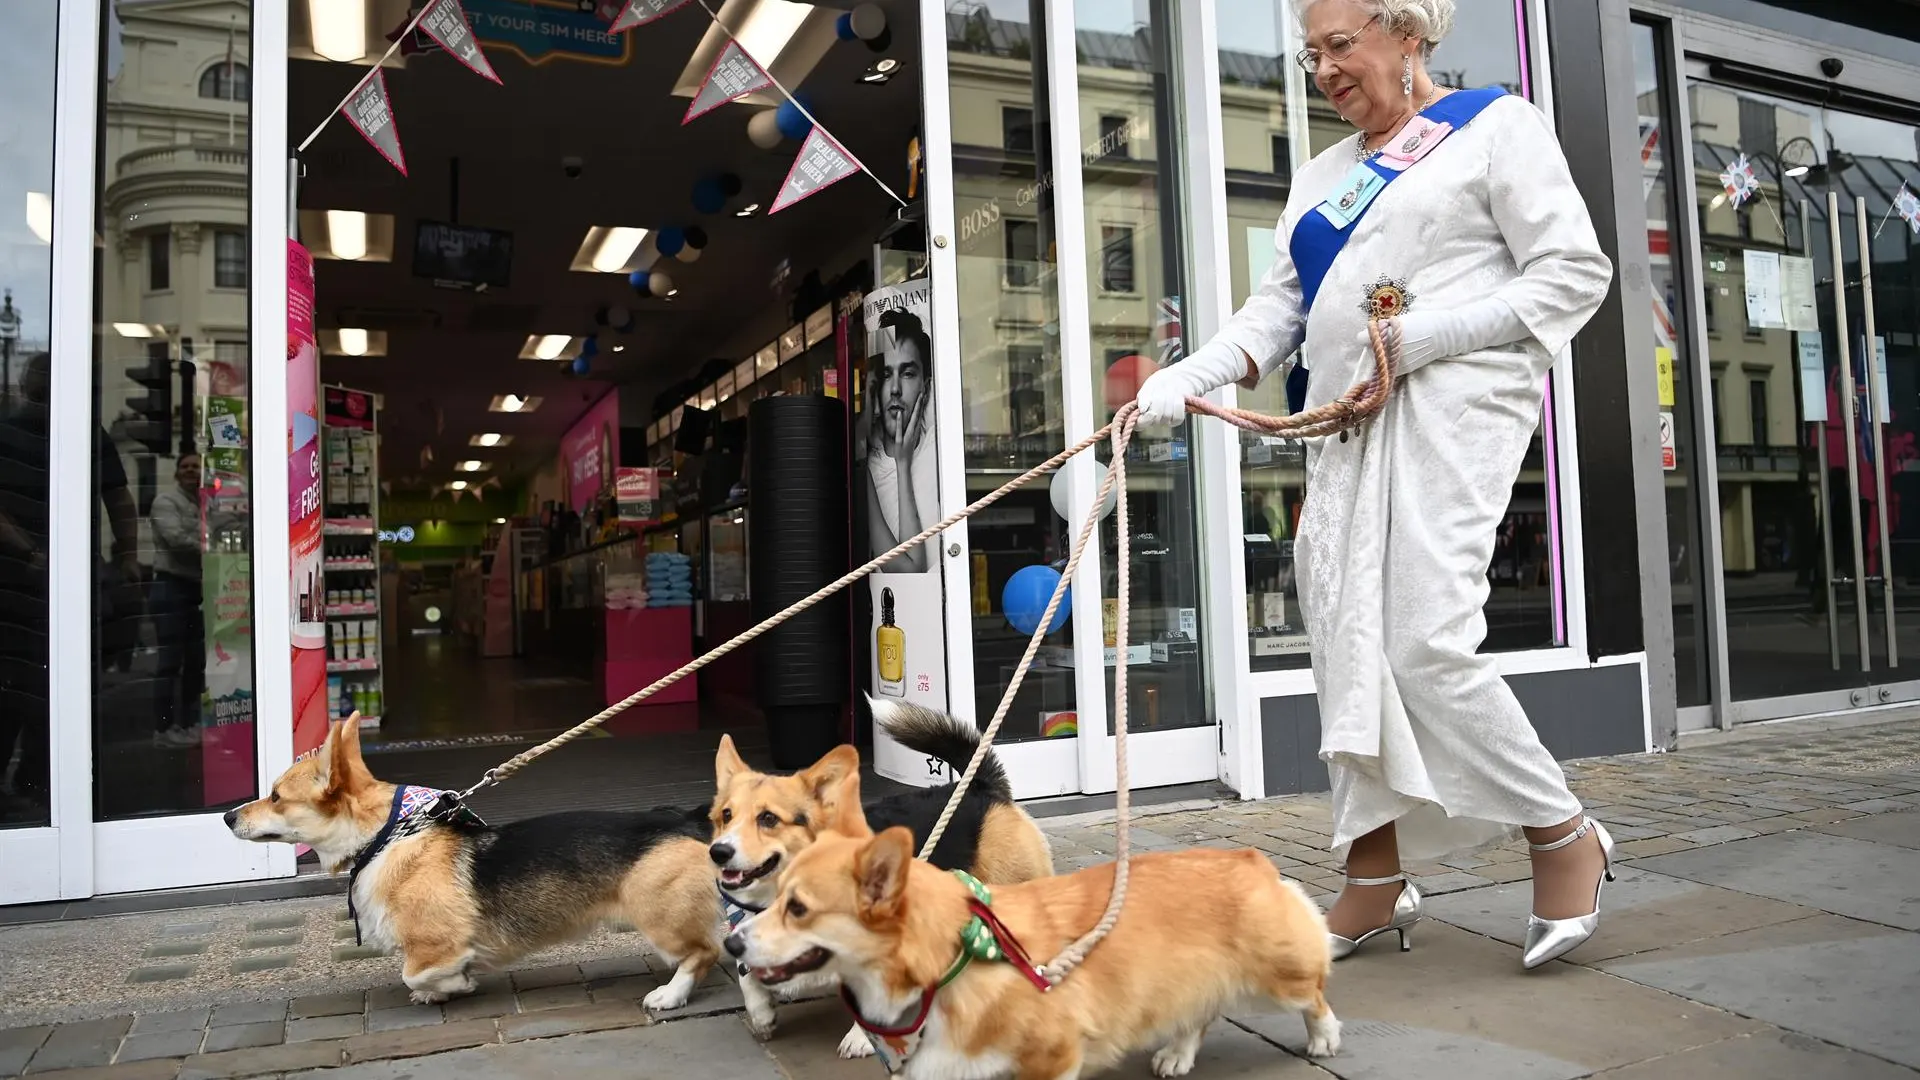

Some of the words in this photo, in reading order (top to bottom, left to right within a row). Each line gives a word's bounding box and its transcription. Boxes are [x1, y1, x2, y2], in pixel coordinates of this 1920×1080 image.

[427, 5, 447, 30] DEALS
[439, 18, 455, 36] FOR
[450, 13, 459, 25] A
[488, 14, 536, 32] YOUR
[540, 22, 569, 38] SIM
[574, 27, 617, 45] HERE
[446, 22, 467, 48] QUEEN
[717, 63, 745, 91] PLATINUM
[727, 59, 751, 84] QUEEN'S
[358, 91, 379, 117] QUEEN'S
[360, 99, 387, 129] PLATINUM
[809, 152, 827, 169] FOR
[822, 164, 832, 174] A
[812, 139, 837, 160] DEALS
[832, 156, 848, 170] FIT
[800, 160, 825, 184] QUEEN
[961, 196, 1000, 240] BOSS
[885, 288, 927, 311] ARMANI
[917, 674, 930, 682] only
[917, 682, 930, 692] £75
[216, 700, 238, 717] DOING
